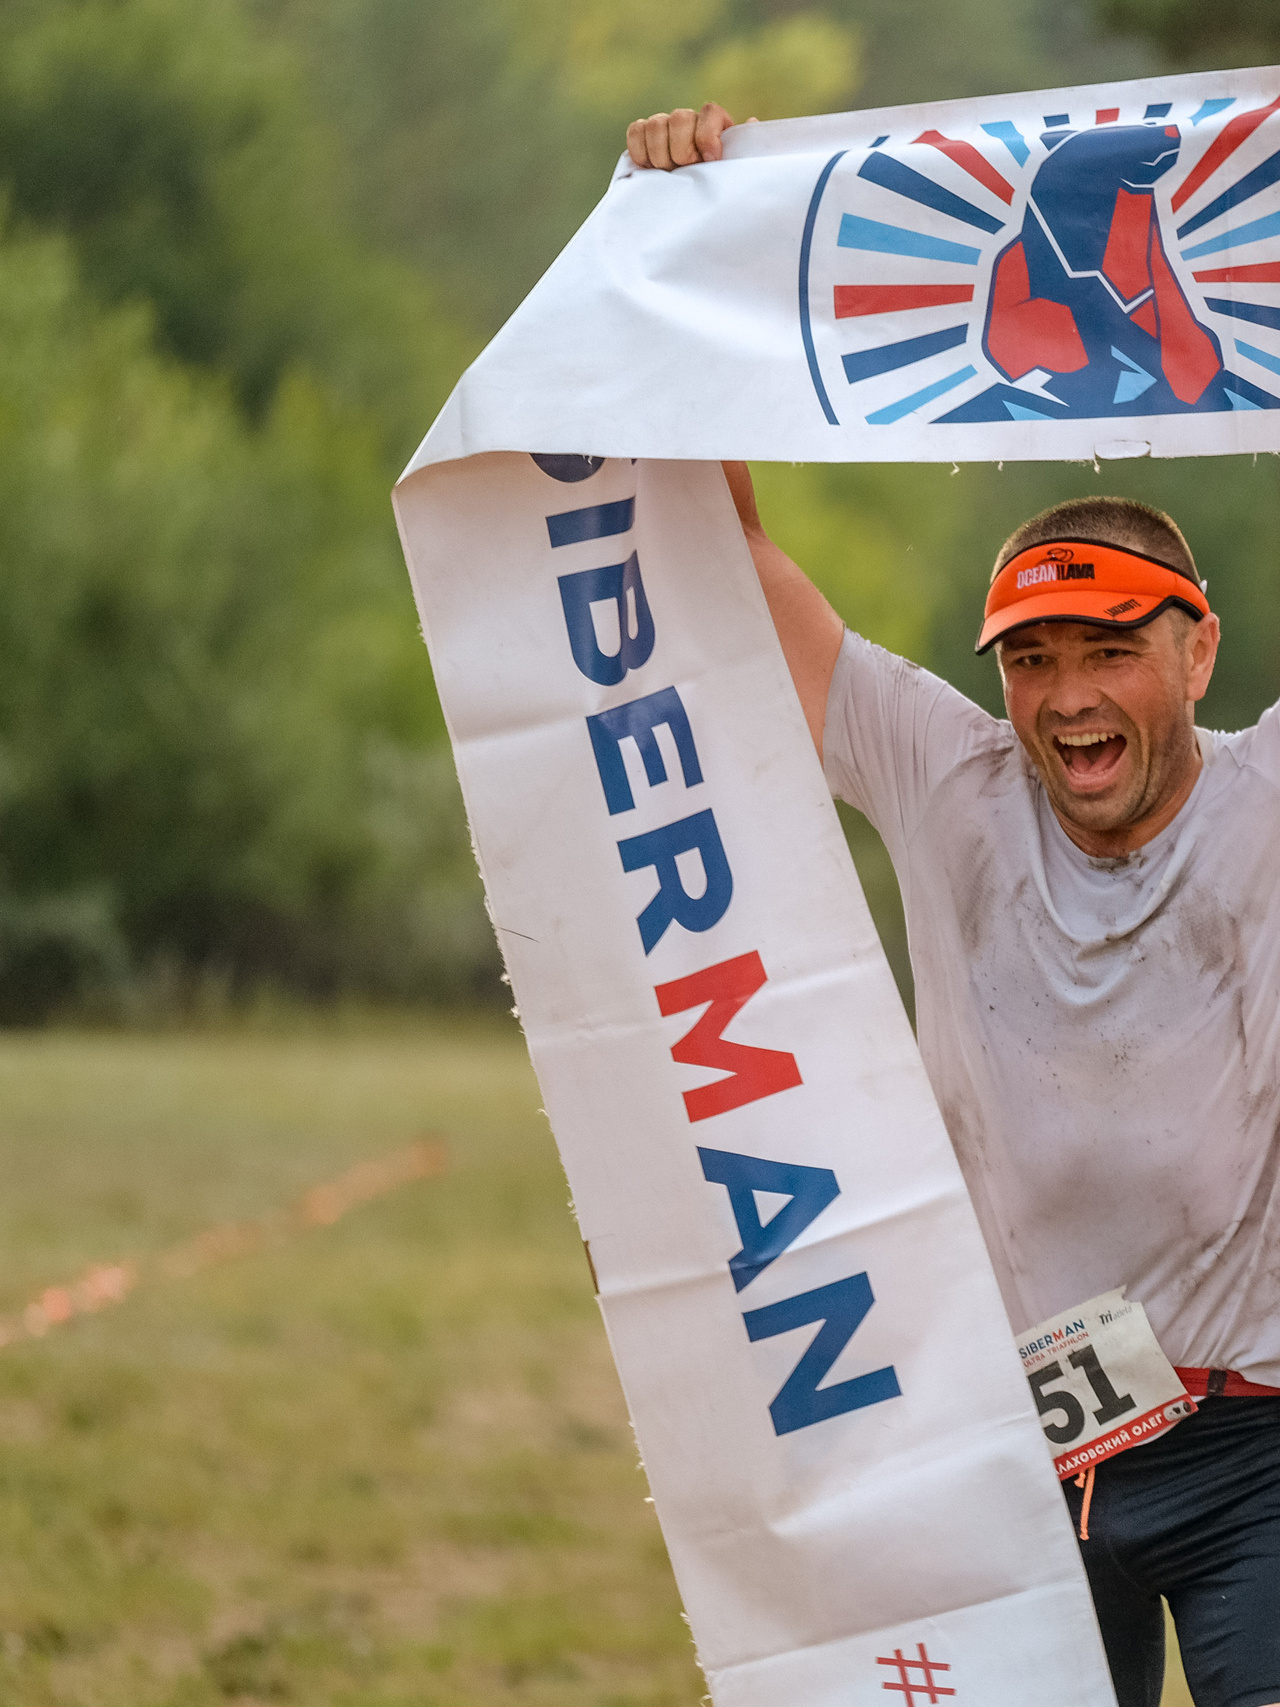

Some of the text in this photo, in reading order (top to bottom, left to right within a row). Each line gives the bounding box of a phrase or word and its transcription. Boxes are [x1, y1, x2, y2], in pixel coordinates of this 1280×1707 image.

[1016, 563, 1056, 589] OCEAN
[1019, 1319, 1086, 1359] SIBERMAN
[1023, 1331, 1089, 1368] ULTRA TRIATHLON
[1027, 1343, 1137, 1445] 51
[1131, 1413, 1163, 1437] ОЛЕГ
